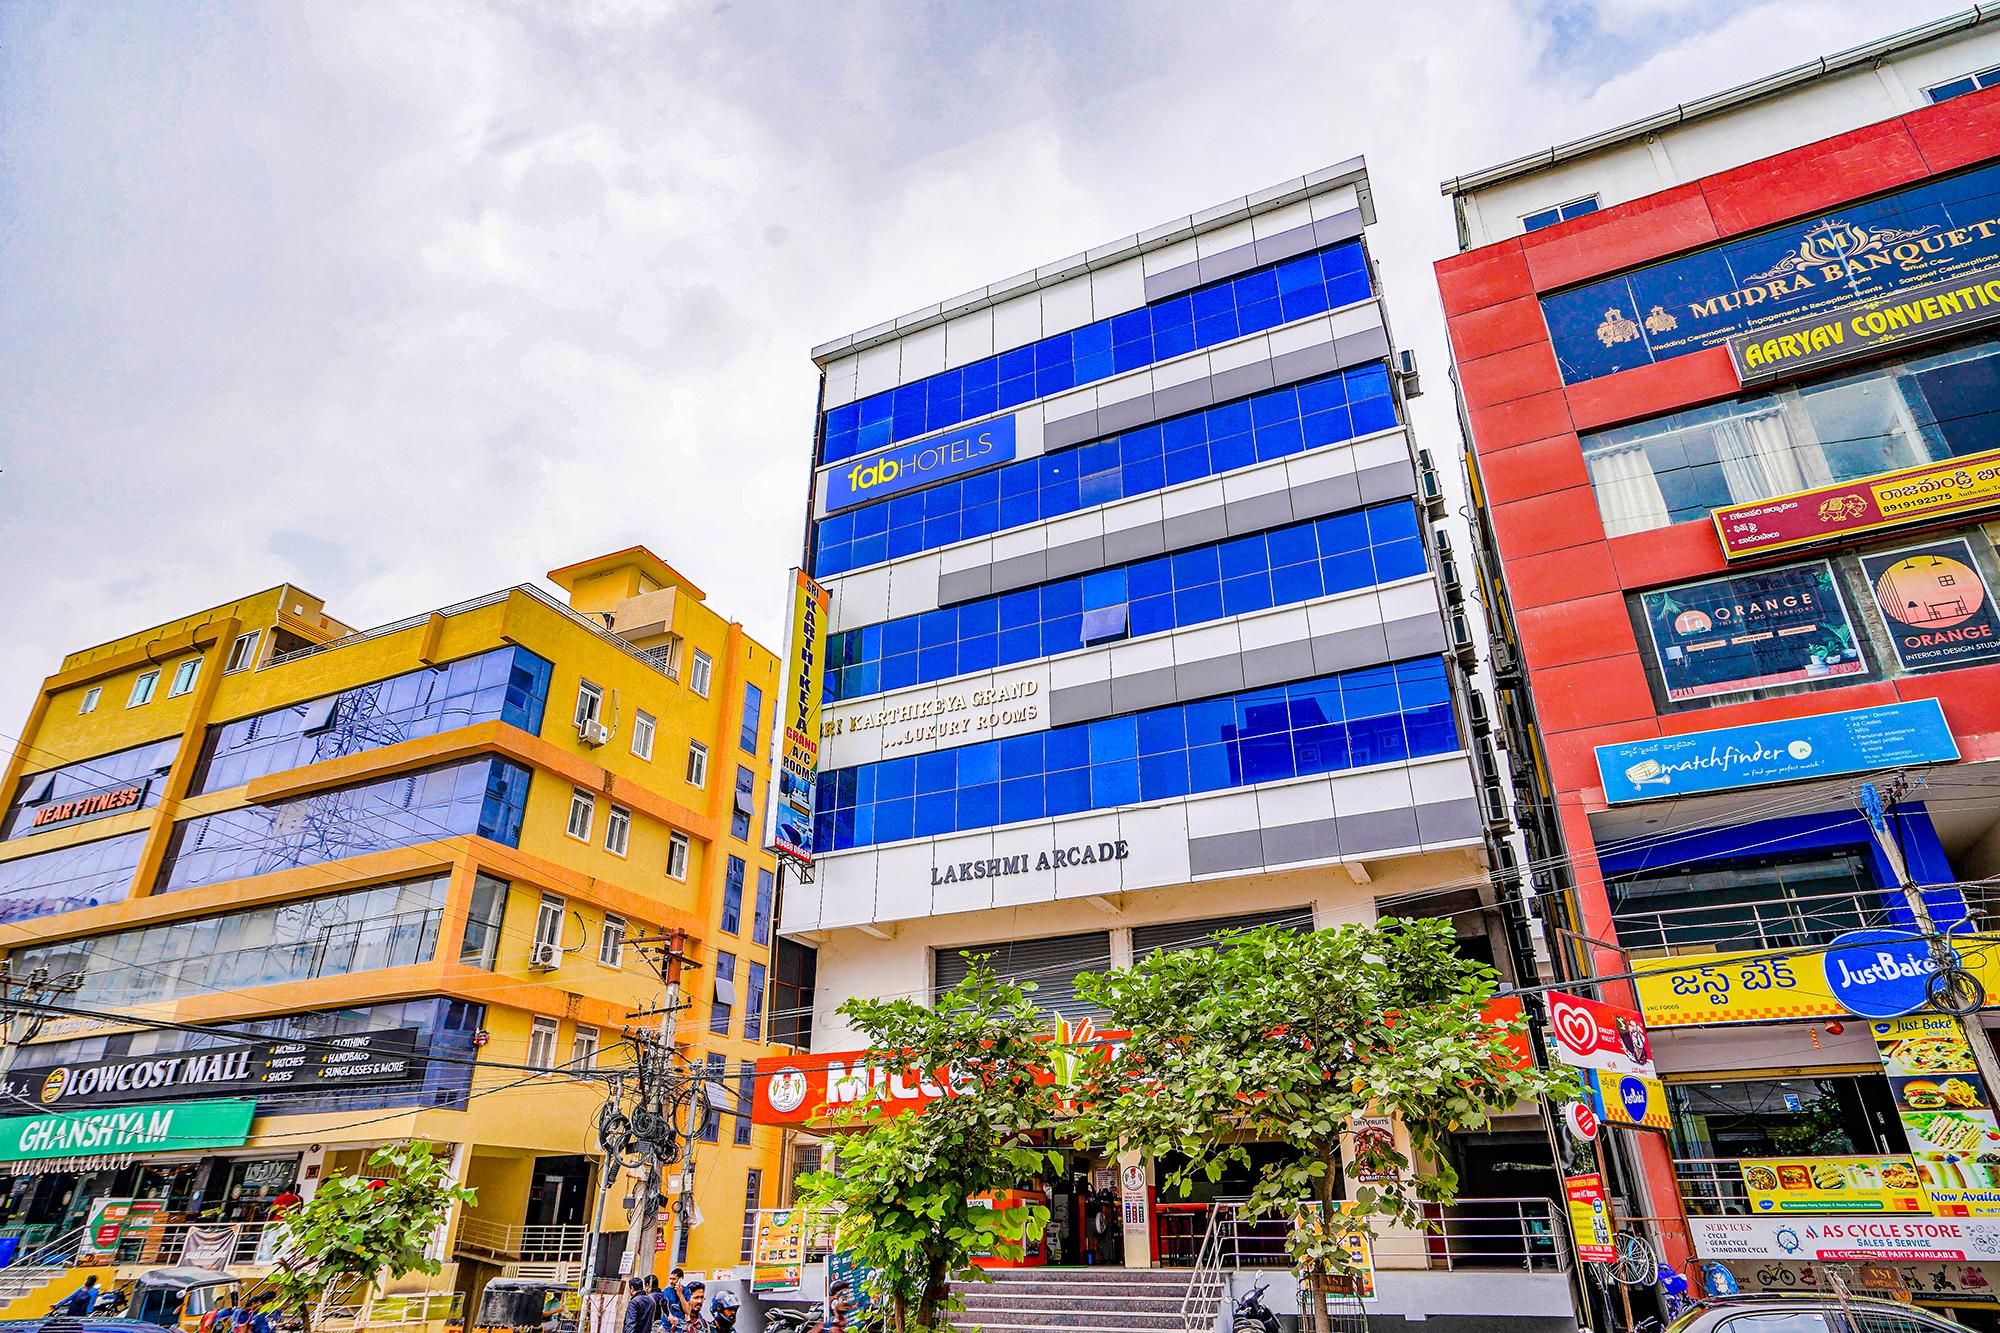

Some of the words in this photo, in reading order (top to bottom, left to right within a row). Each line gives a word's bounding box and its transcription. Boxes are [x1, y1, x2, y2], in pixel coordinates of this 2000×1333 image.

[1651, 339, 1686, 351] Wedding
[1687, 326, 1735, 342] Ceremonies
[1748, 307, 1800, 326] Engagement
[1809, 293, 1853, 309] Reception
[1855, 285, 1884, 297] Events
[1899, 270, 1937, 284] Sangeet
[1939, 254, 1999, 274] Celebrations
[1688, 273, 1817, 320] MUDRA
[1745, 322, 1844, 369] AARYAV
[847, 432, 993, 492] fabHOTELS
[1883, 493, 1952, 512] 8919192375
[1958, 487, 1991, 498] Authentic
[806, 580, 819, 598] SRI
[1714, 593, 1812, 620] ORANGE
[1904, 624, 1993, 649] ORANGE
[796, 595, 817, 735] KARTHIKEYA
[1905, 649, 1942, 661] INTERIOR
[1943, 645, 1975, 656] DESIGN
[849, 693, 968, 733] KARTHIKEYA
[972, 679, 1038, 706] GRAND
[976, 704, 1038, 730] ROOMS
[786, 726, 817, 754] GRAND
[792, 744, 811, 765] A/C
[1661, 741, 1785, 774] matchfinder
[783, 755, 816, 784] ROOMS
[32, 803, 71, 828] NEAR
[74, 787, 140, 817] FITNESS
[930, 853, 1030, 886] LAKSHMI
[1034, 840, 1129, 871] ARCADE
[1837, 952, 1938, 989] JustBake
[1671, 967, 1730, 1005] జస్ట్
[1896, 1019, 1918, 1033] Just
[1922, 1018, 1952, 1030] Bake
[271, 1056, 307, 1068] WATCHES
[324, 1064, 374, 1078] SUNGLASSES
[373, 1064, 380, 1073] &
[380, 1061, 405, 1073] MORE
[327, 1053, 370, 1064] HANDBAGS
[64, 1060, 182, 1097] LOWCOST
[182, 1050, 252, 1084] MALL
[267, 1072, 294, 1082] SHOES
[19, 1109, 175, 1152] GHANSHYAM
[1931, 1192, 1957, 1202] Now
[1705, 1223, 1752, 1232] SERVICES
[1823, 1225, 1844, 1238] AS
[1847, 1224, 1900, 1238] CYCLE
[1904, 1224, 1963, 1238] STORE
[1856, 1238, 1885, 1247] SALES
[1887, 1239, 1893, 1247] &
[1895, 1239, 1932, 1248] SERVICE
[1888, 1251, 1913, 1259] PARTS
